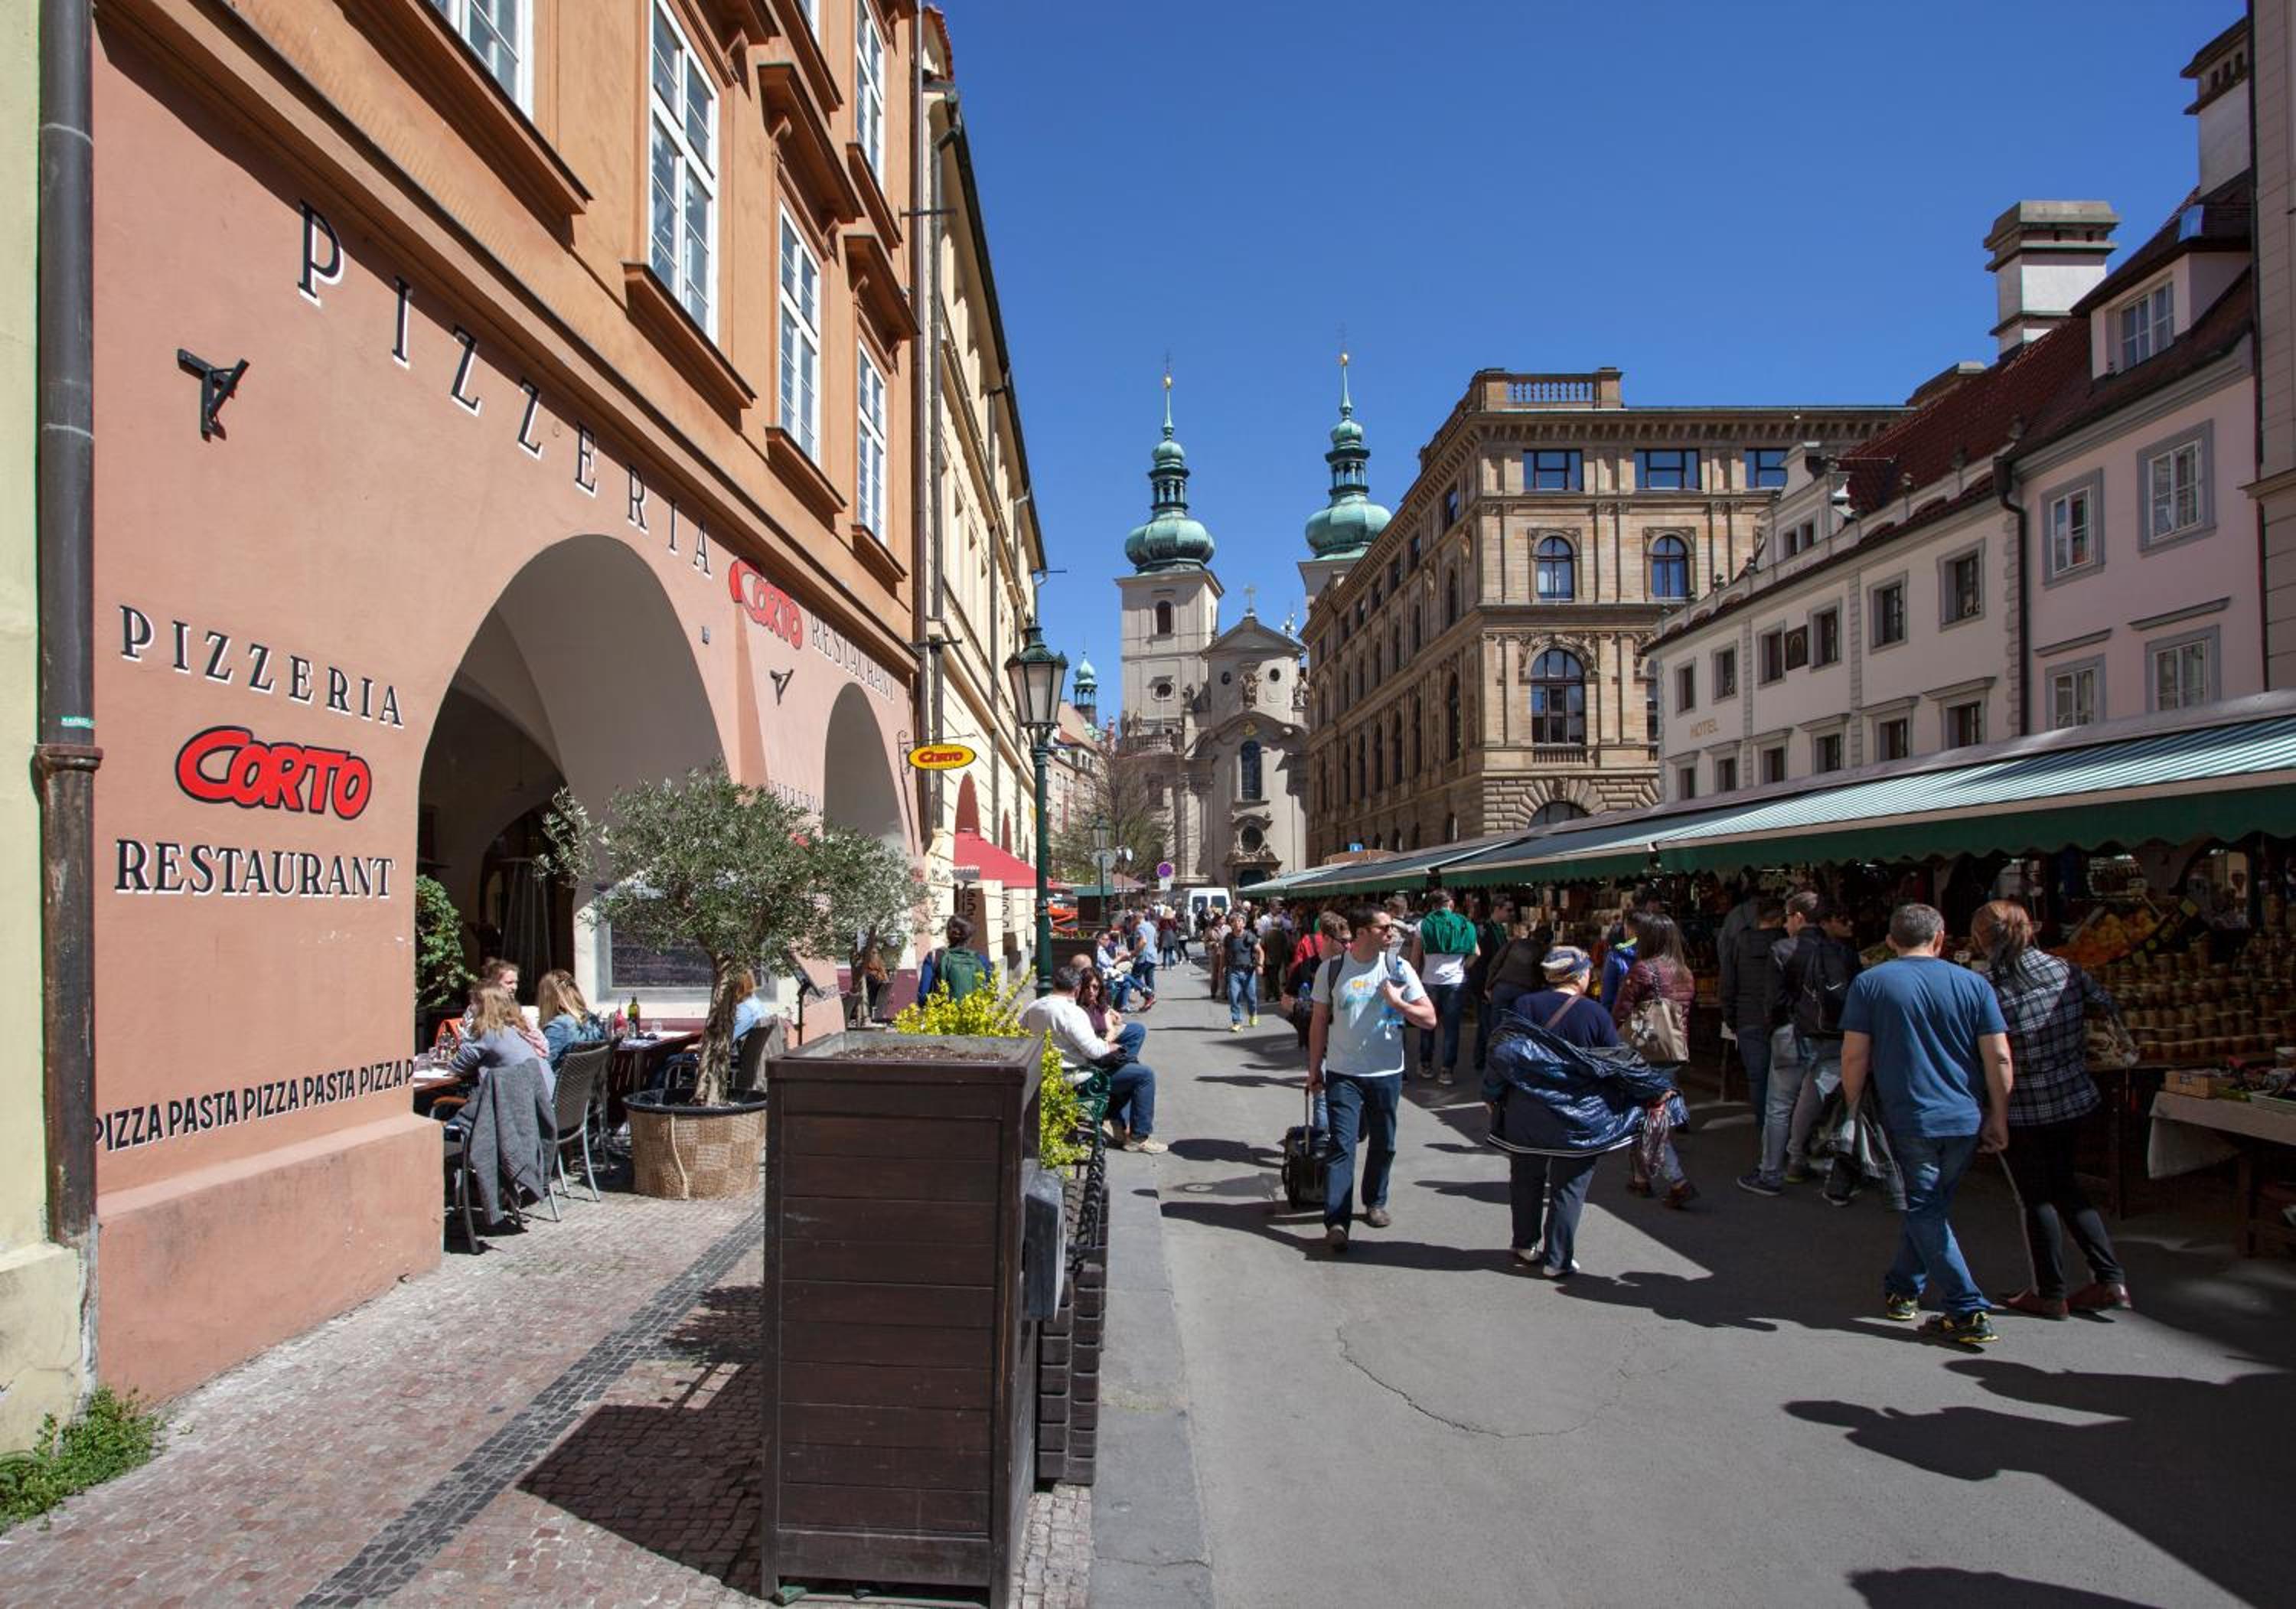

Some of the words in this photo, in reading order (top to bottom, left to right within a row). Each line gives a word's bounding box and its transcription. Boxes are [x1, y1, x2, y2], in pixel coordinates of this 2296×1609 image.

[298, 198, 712, 579] PIZZERIA
[729, 560, 802, 650] CORTO
[119, 605, 404, 729] PIZZERIA
[175, 725, 372, 821] CORTO
[114, 839, 395, 899] RESTAURANT
[168, 1090, 239, 1137] PASTA
[243, 1079, 299, 1123] PIZZA
[303, 1069, 356, 1108] PASTA
[359, 1061, 403, 1096] PIZZA
